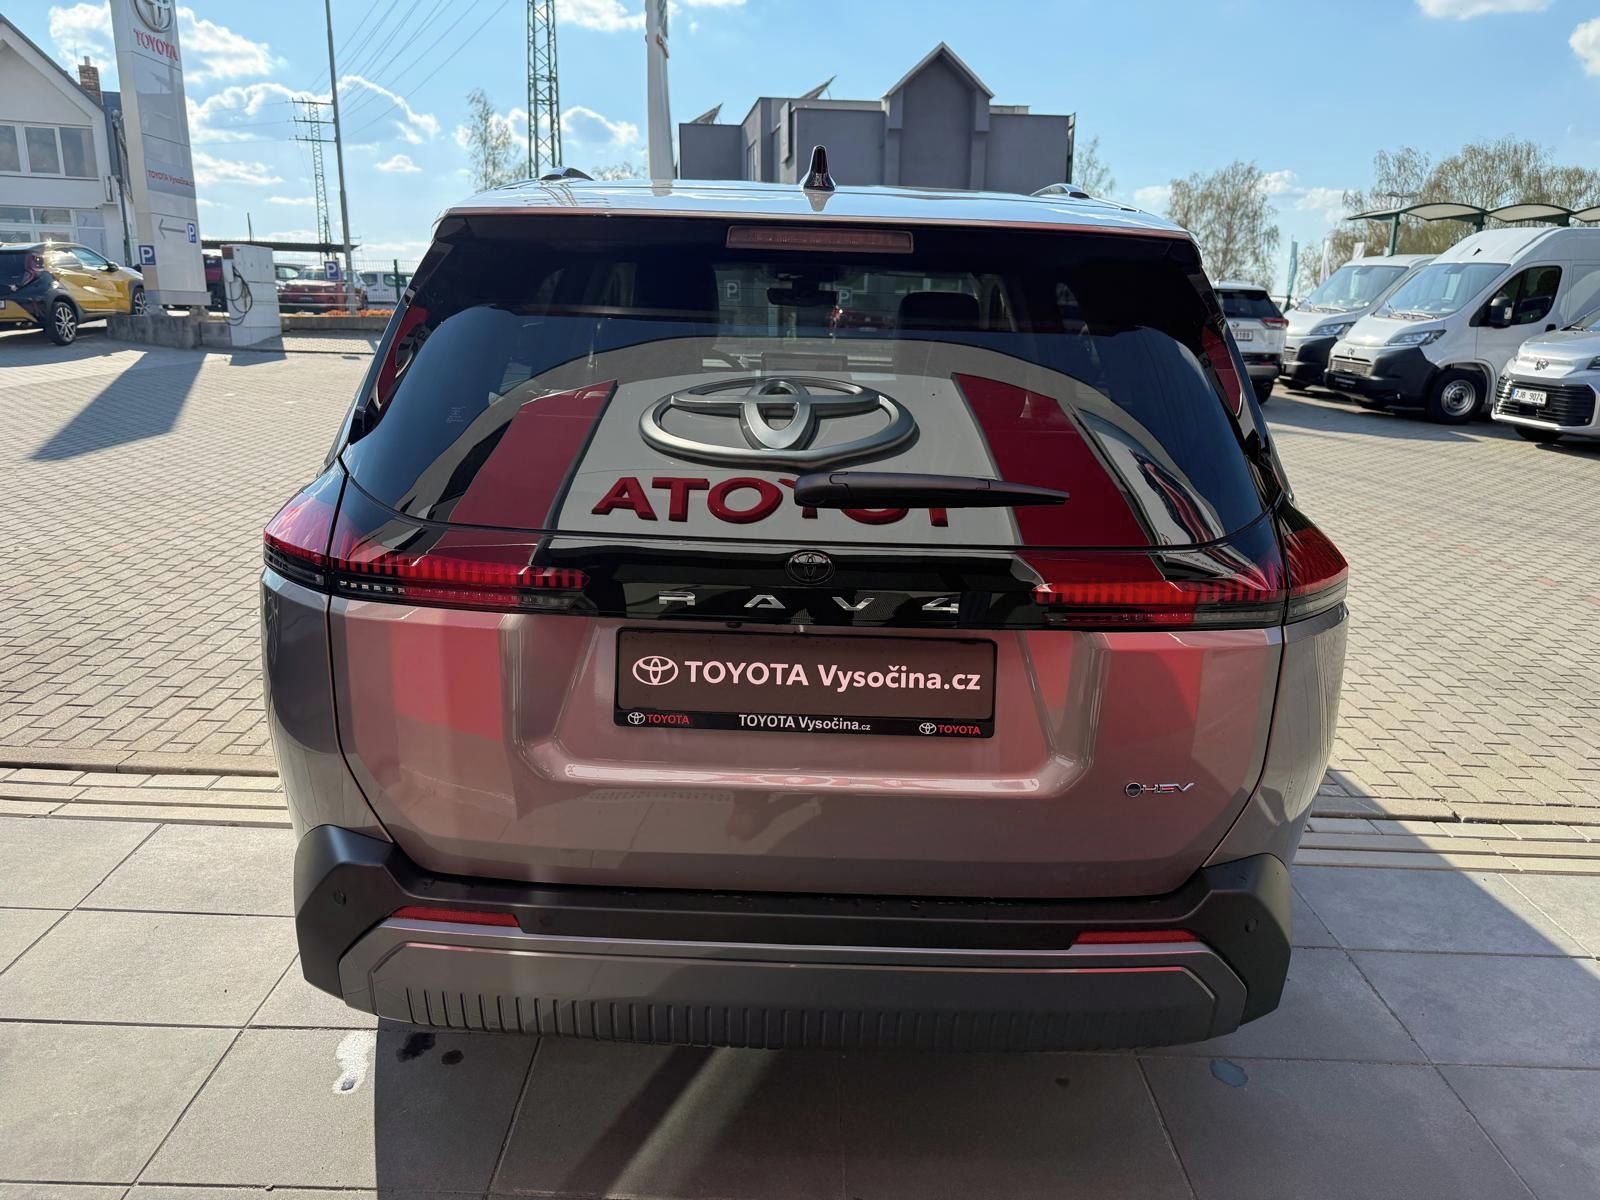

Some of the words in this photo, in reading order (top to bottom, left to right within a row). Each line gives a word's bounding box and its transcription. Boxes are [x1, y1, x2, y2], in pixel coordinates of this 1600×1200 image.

[133, 28, 178, 61] TOYOTA
[141, 247, 152, 264] P
[326, 262, 336, 279] P
[658, 591, 960, 615] RAV4
[684, 660, 809, 686] TOYOTA
[817, 664, 981, 693] Vysočina.cz
[646, 714, 690, 725] TOYOTA
[738, 714, 796, 729] TOYOTA
[798, 716, 871, 732] Vysočina.cz
[938, 724, 981, 735] TOYOTA
